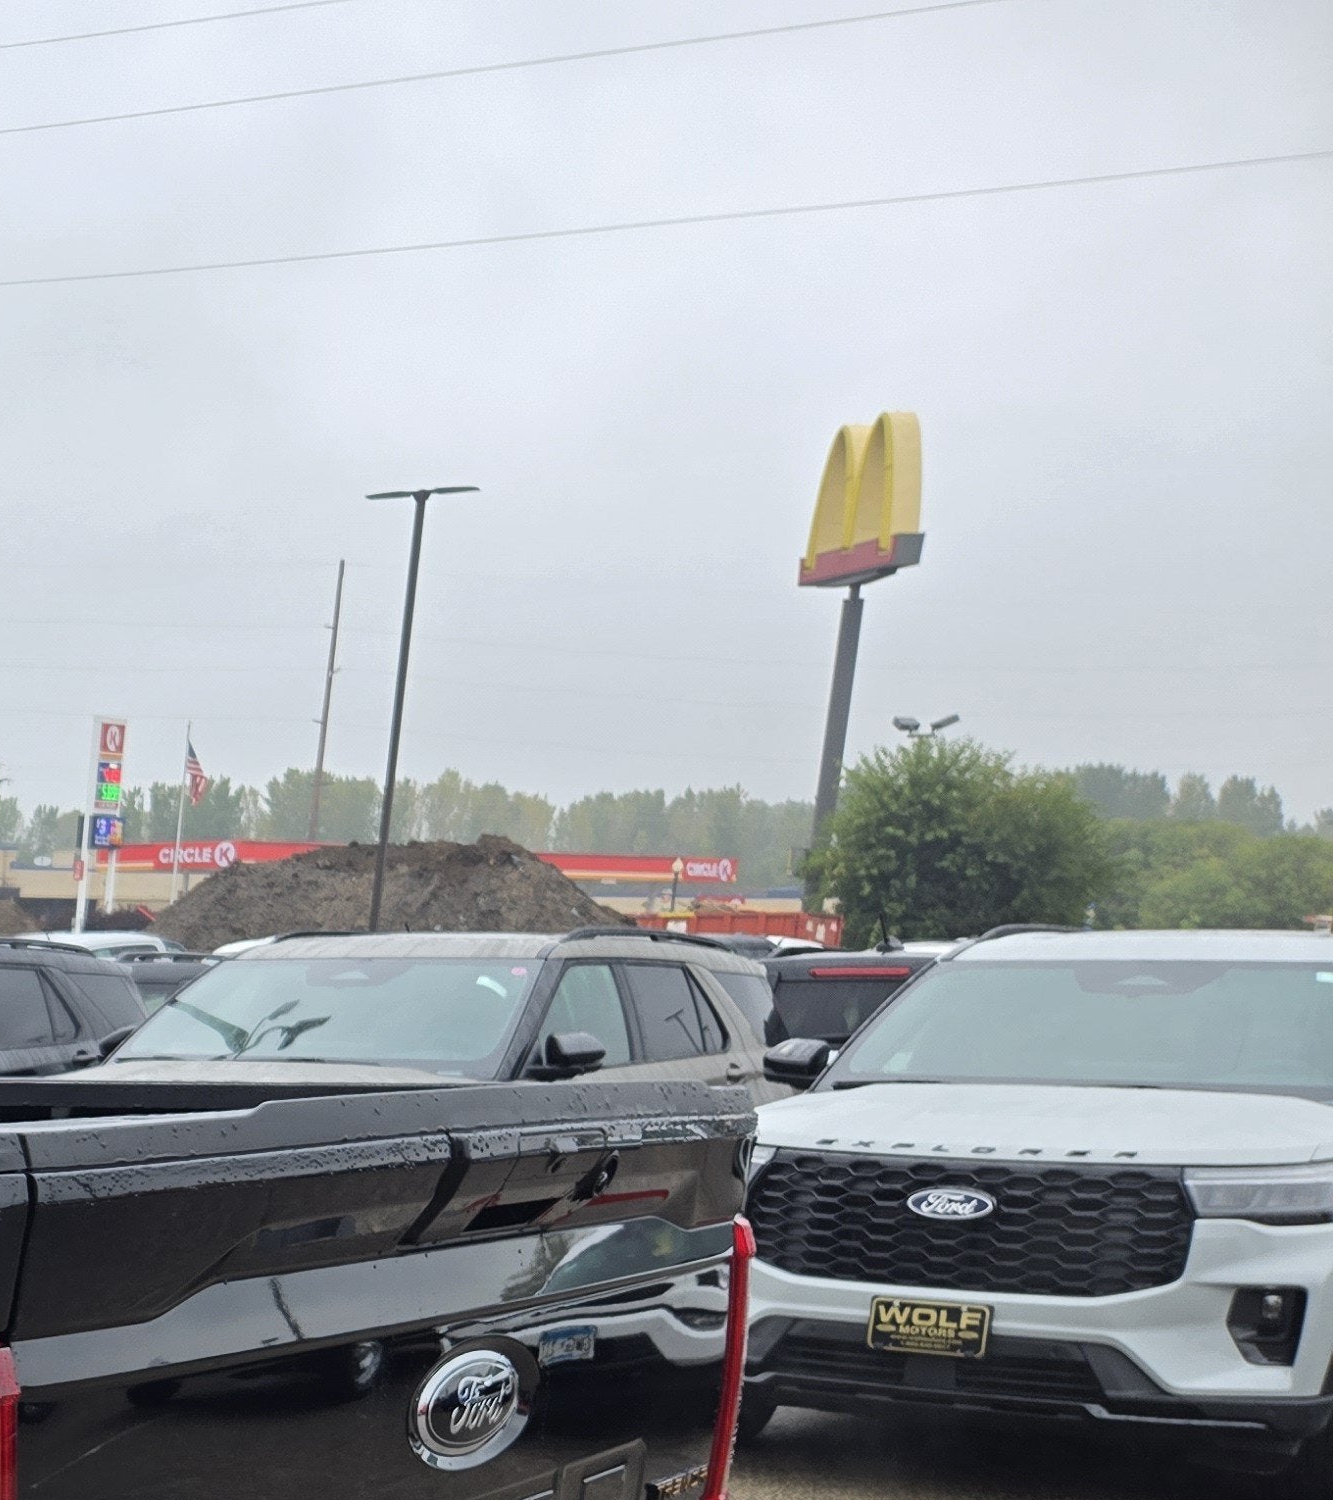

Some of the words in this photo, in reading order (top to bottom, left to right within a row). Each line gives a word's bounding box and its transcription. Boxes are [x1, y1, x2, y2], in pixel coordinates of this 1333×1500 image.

[159, 847, 212, 864] CIRCLE
[816, 1137, 1138, 1158] EXPLORER
[920, 1193, 978, 1214] Ford
[878, 1305, 981, 1329] WOLF
[899, 1325, 955, 1338] MOTORS
[450, 1366, 514, 1434] Ford
